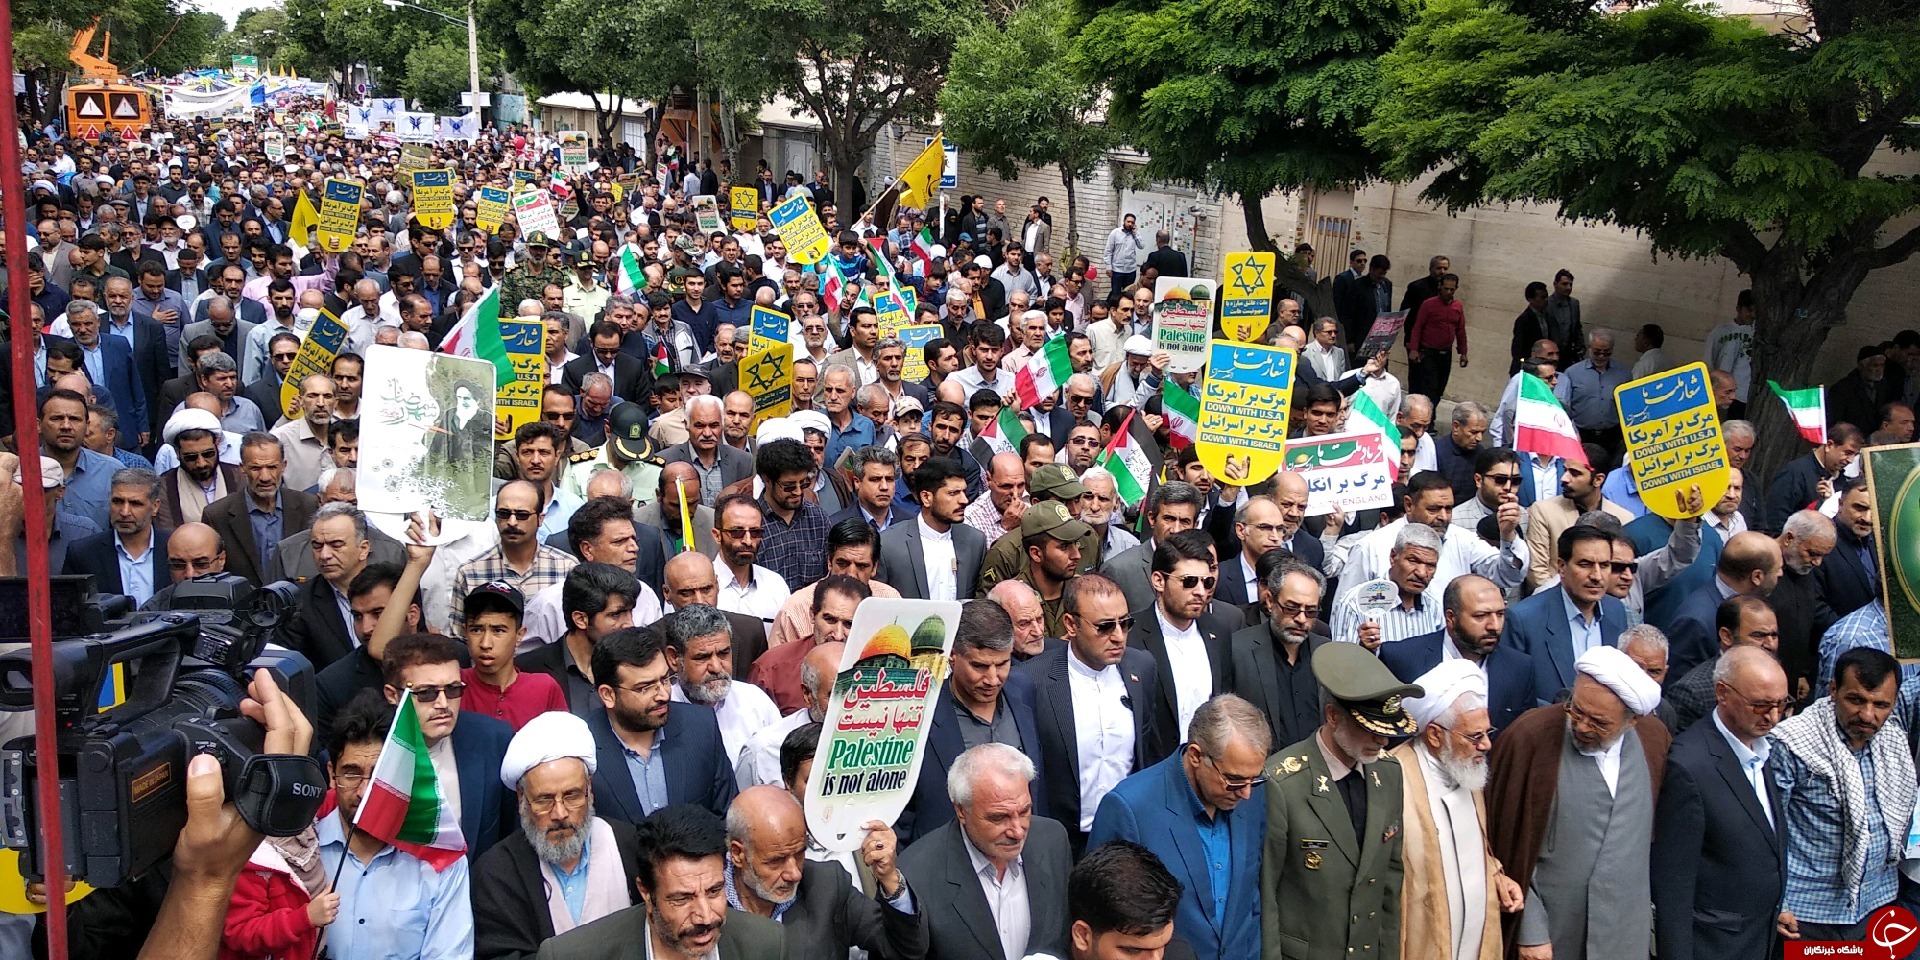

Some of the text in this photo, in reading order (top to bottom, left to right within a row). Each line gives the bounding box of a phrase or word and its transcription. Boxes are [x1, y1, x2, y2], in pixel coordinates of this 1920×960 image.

[1161, 302, 1207, 319] فلسطین
[1160, 319, 1205, 330] تنها نیست
[501, 325, 538, 346] شعار ملت
[752, 337, 770, 350] آمریکا
[1160, 329, 1205, 343] Palestine
[1167, 342, 1181, 350] not
[1182, 344, 1204, 352] alone
[518, 359, 540, 372] مرگ
[1233, 349, 1285, 377] شعار ملت ما
[507, 386, 515, 396] بر
[518, 384, 540, 396] مرگ
[1207, 383, 1286, 409] مرگ بر آمریکا
[1643, 375, 1700, 404] شعار ملت ما
[1207, 403, 1282, 420] DOWN WITH U.S.A
[1202, 415, 1283, 438] مرگ بر اسرائیل
[1628, 411, 1713, 445] مرگ بر آمریکا
[1202, 434, 1278, 450] DOWN WITH ISRAEL
[1636, 430, 1715, 459] DOWN WITH U.S.A
[1638, 443, 1720, 477] مرگ بر اسرائیل
[1353, 472, 1385, 490] مرگ
[1643, 461, 1722, 489] DOWN WITH ISRAEL
[1337, 479, 1348, 494] بر
[1343, 494, 1387, 505] ENGLAND
[843, 666, 931, 709] فلسطین
[836, 704, 923, 737] تنها نیست
[828, 736, 915, 770] Palestine
[292, 783, 322, 798] SONY
[822, 768, 907, 796] is not alone
